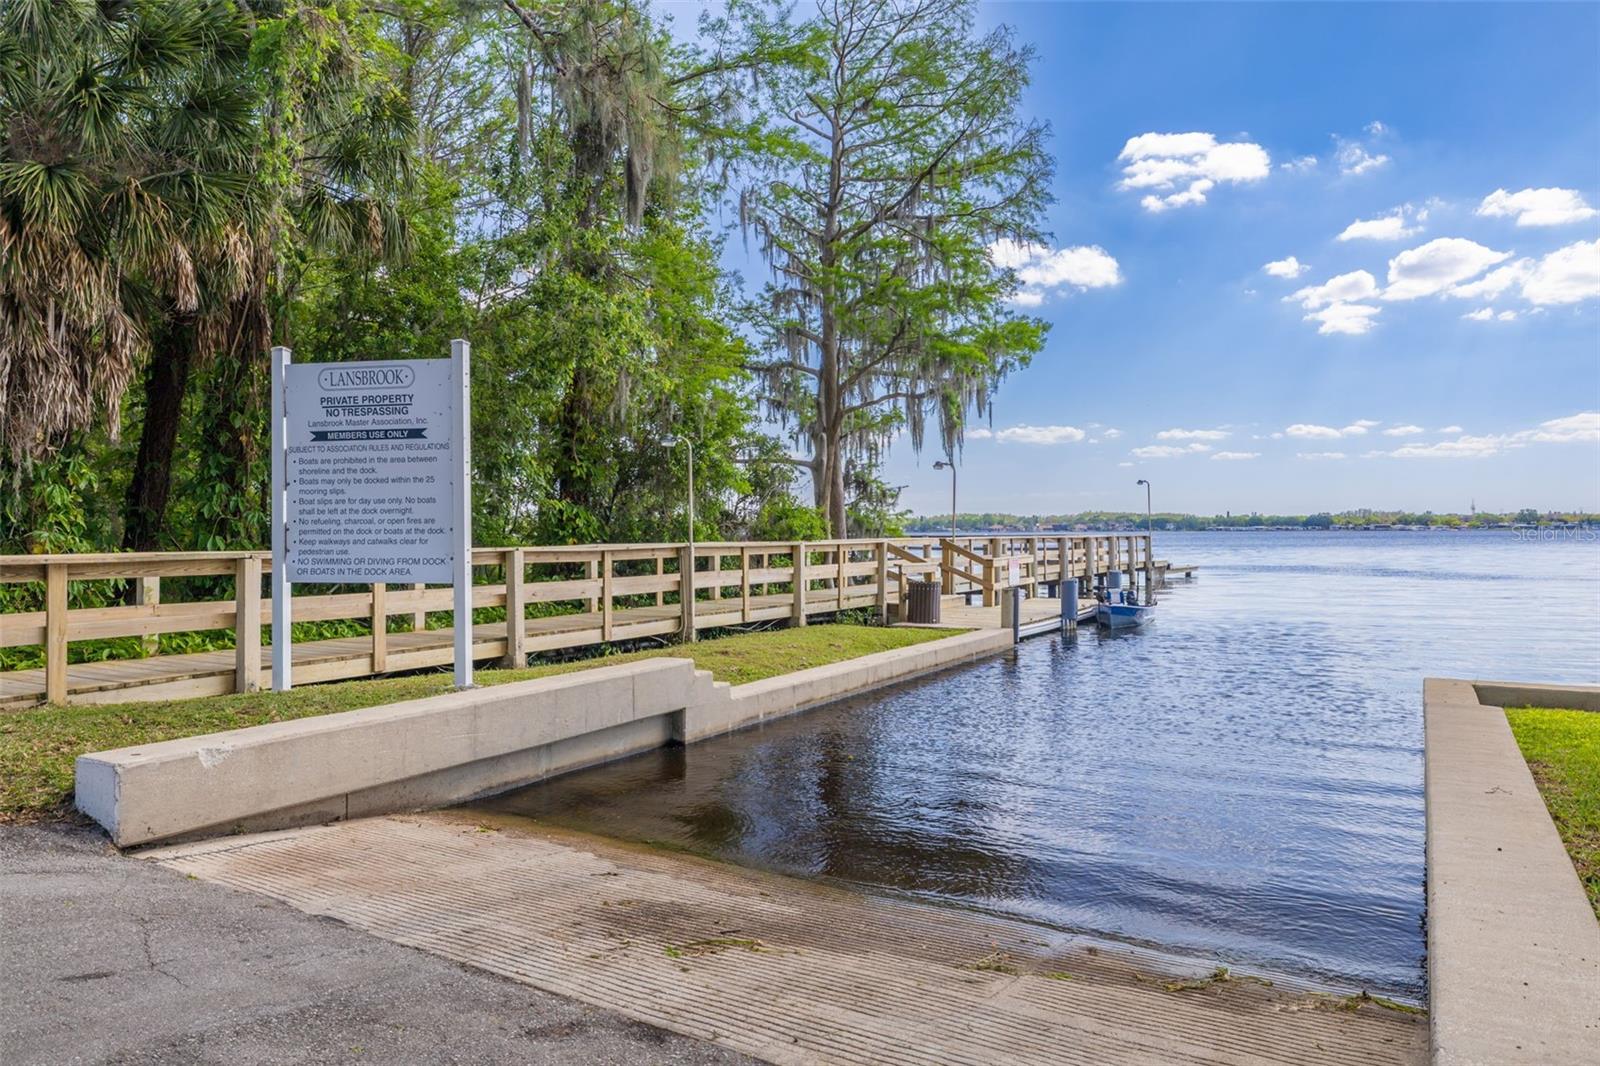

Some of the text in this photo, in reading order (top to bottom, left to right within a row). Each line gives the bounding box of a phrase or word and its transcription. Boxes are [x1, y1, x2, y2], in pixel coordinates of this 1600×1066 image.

[329, 369, 404, 386] LANSBROOK
[320, 394, 414, 405] PRIVATE PROPERTY
[326, 406, 408, 417] NO TRESPASSING
[308, 419, 343, 427] Lansbrook
[328, 431, 367, 439] MEMBERS
[406, 442, 449, 450] REGULATIONS
[333, 457, 367, 465] prohibited
[321, 478, 335, 486] may
[337, 477, 351, 486] only
[299, 488, 327, 496] mooring
[317, 497, 332, 506] slips
[359, 497, 371, 505] day
[299, 507, 315, 515] shall
[299, 528, 331, 537] permitted
[299, 538, 316, 546] Keep
[318, 538, 350, 546] walkways
[400, 537, 418, 545] clear
[298, 548, 334, 556] pedestrian
